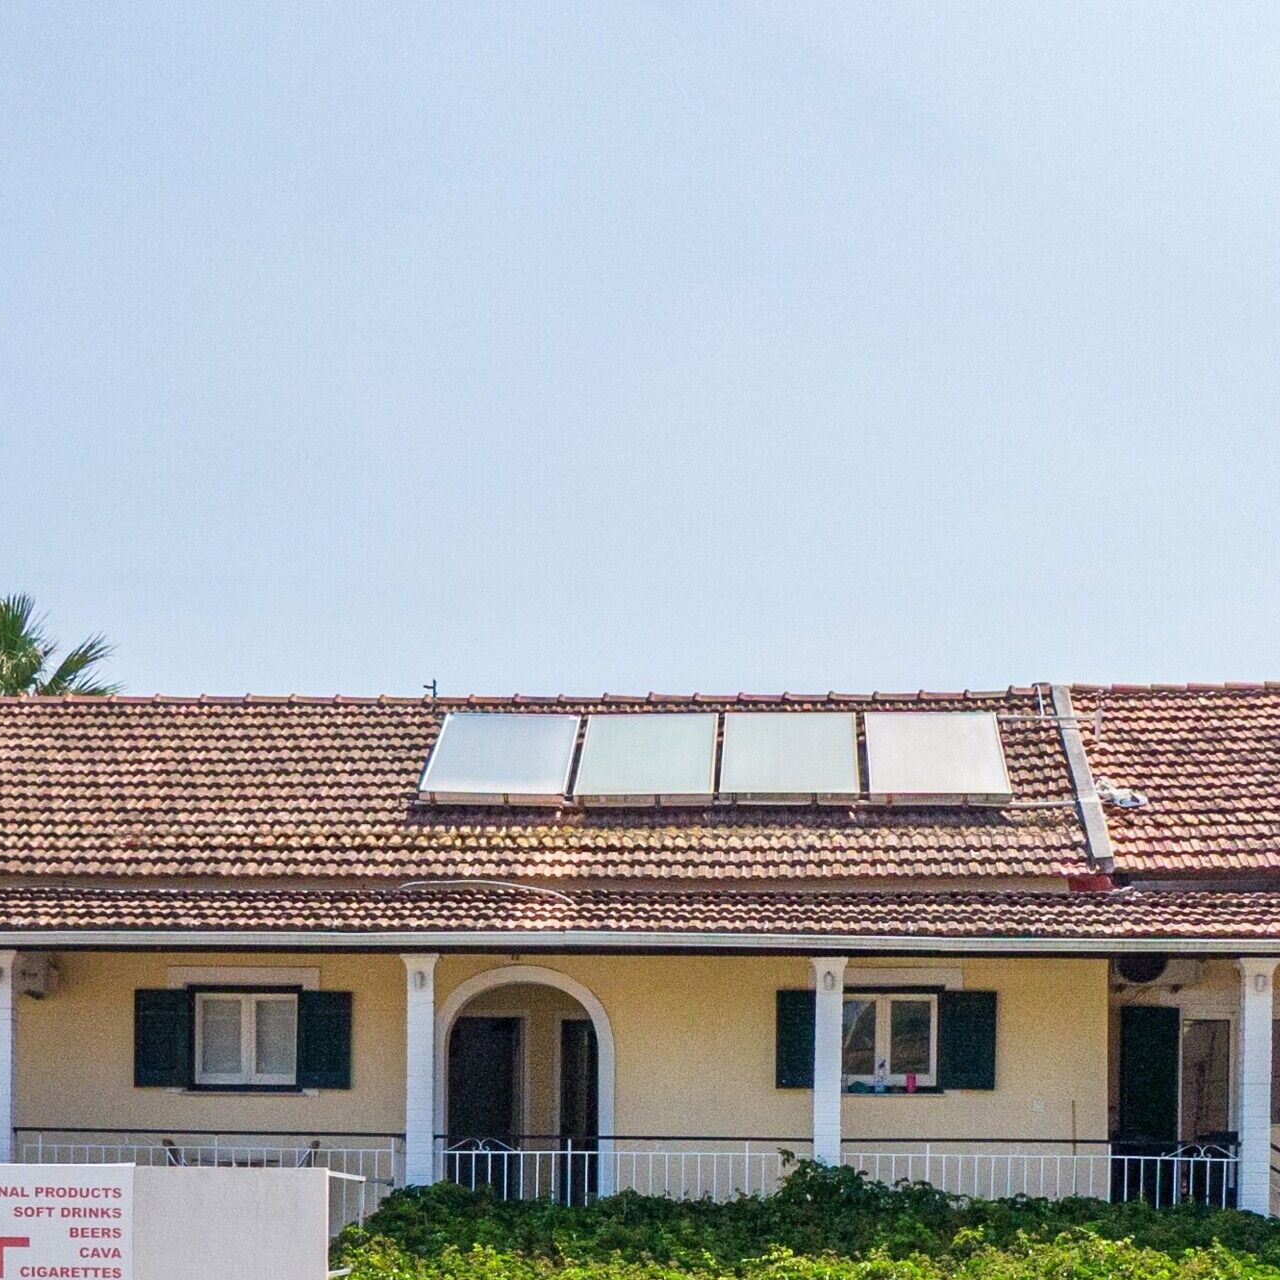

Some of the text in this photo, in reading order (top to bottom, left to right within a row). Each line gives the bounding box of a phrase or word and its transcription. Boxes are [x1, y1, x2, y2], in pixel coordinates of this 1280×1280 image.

[34, 1186, 122, 1199] PRODUCTS
[13, 1206, 122, 1219] SOFT DRINKS
[69, 1227, 122, 1239] BEERS
[79, 1247, 122, 1259] CAVA
[20, 1267, 122, 1279] CIGARETTES
